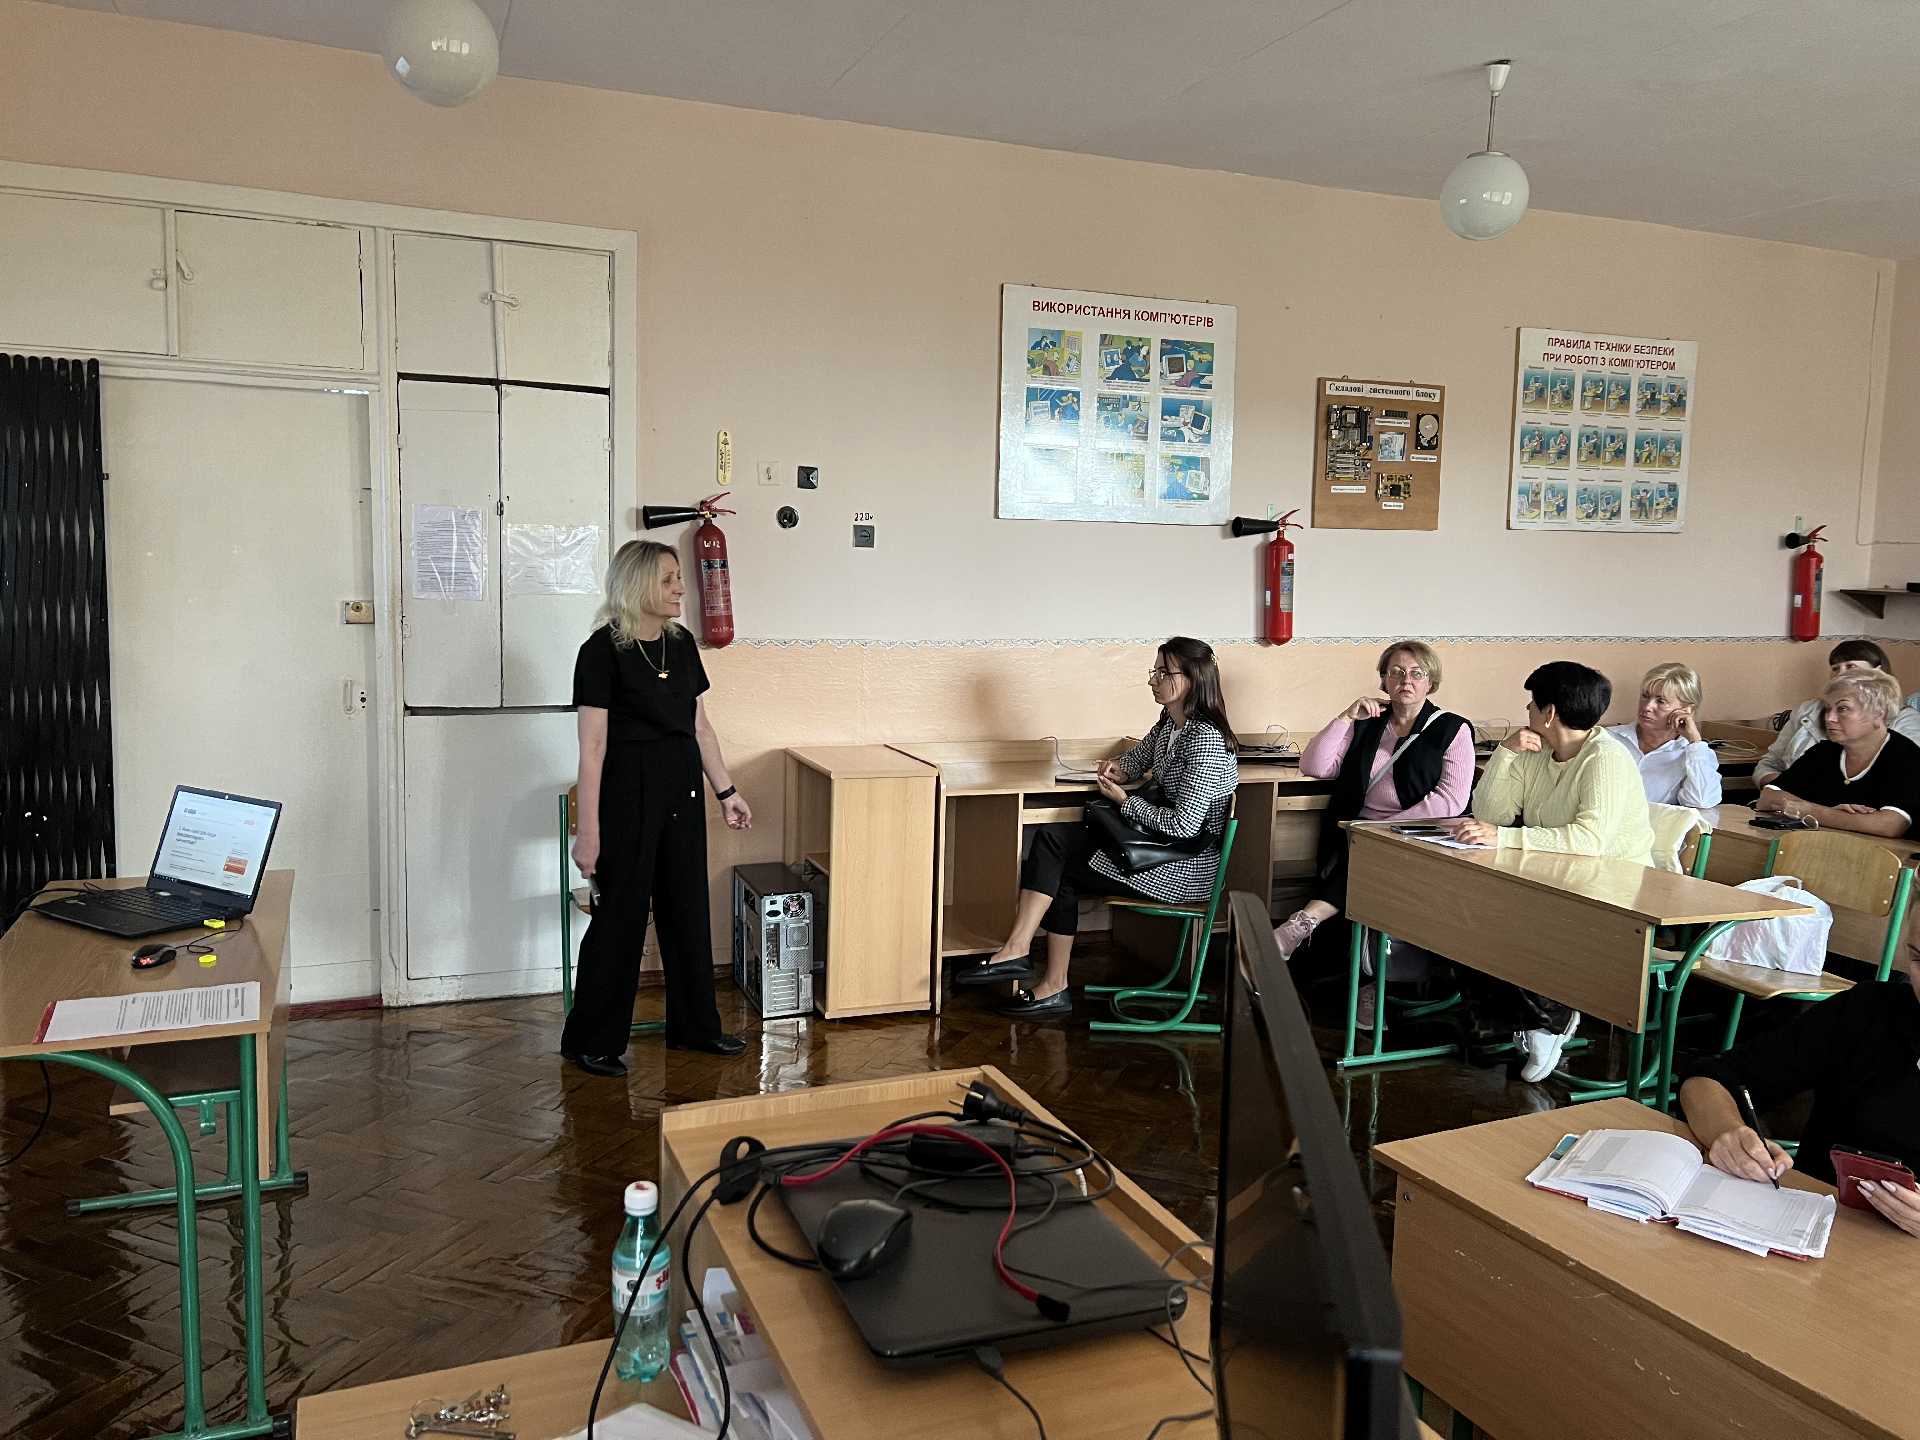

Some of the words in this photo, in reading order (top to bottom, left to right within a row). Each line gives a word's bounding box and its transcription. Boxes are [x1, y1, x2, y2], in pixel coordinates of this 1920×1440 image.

[1032, 300, 1131, 320] ВИКОРИСТАННЯ
[1547, 337, 1591, 350] ПРАВИЛА
[1594, 341, 1632, 353] ТЕХНІКИ
[1633, 345, 1675, 356] БЕЗПЕКИ
[1542, 352, 1561, 362] ПРИ
[1564, 354, 1599, 365] РОБОТІ
[1600, 356, 1606, 366] З
[1329, 383, 1364, 393] Складові
[1415, 389, 1437, 400] блоку
